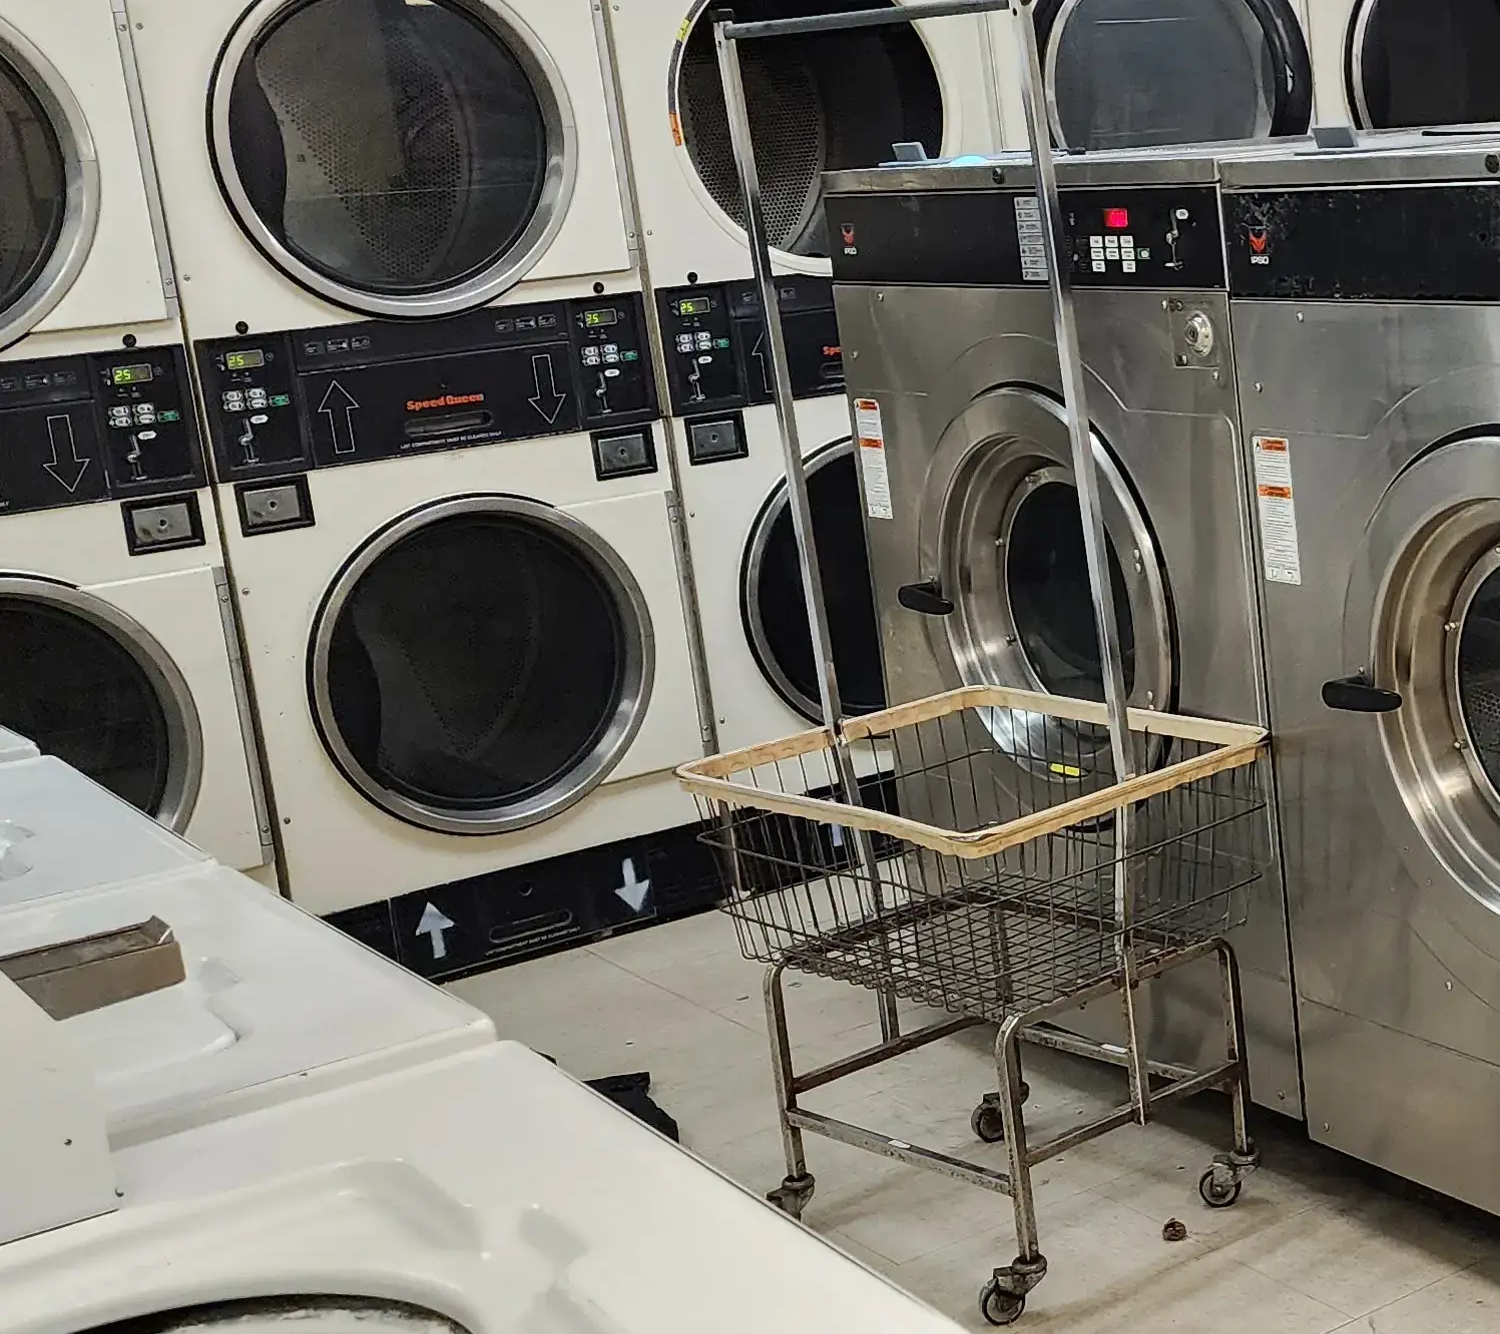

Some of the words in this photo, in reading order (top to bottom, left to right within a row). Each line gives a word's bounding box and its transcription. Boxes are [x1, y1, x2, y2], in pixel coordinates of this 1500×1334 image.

[228, 354, 245, 366] 25
[115, 369, 131, 381] 25
[406, 397, 446, 411] Speed
[445, 393, 484, 405] Queen
